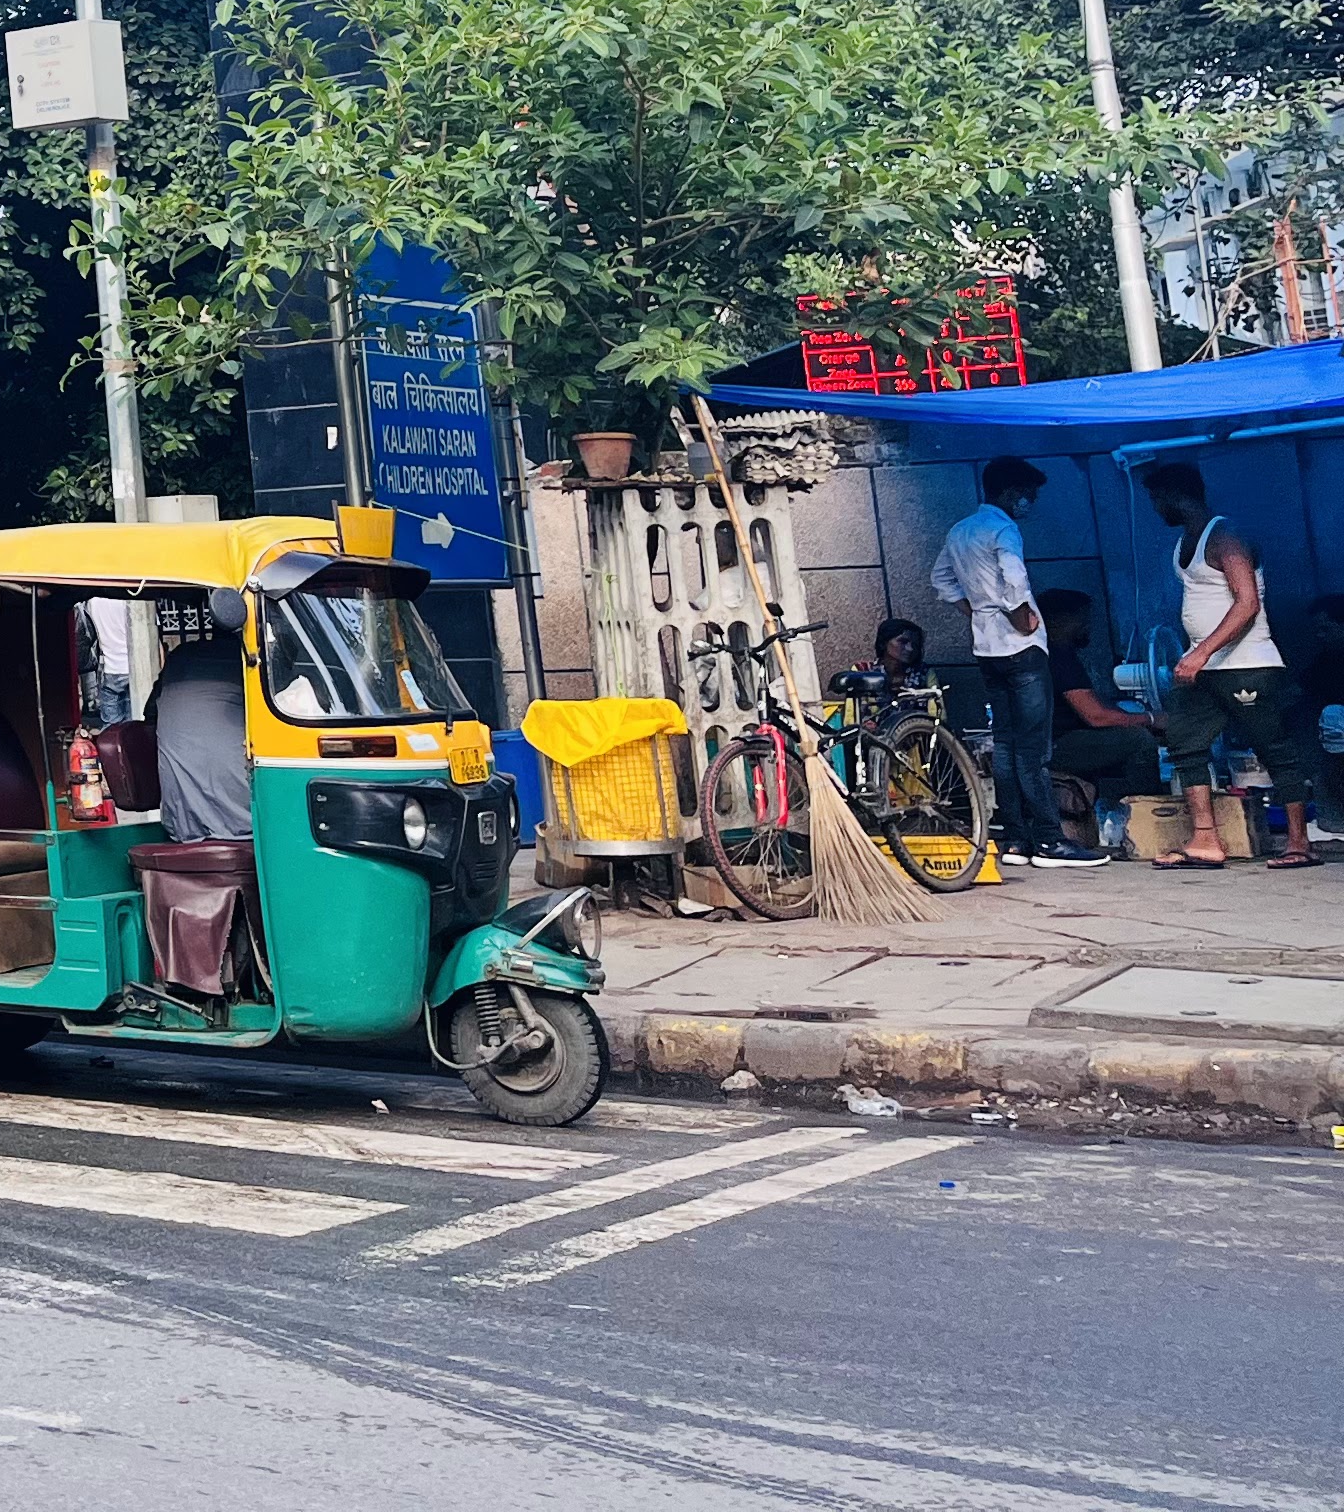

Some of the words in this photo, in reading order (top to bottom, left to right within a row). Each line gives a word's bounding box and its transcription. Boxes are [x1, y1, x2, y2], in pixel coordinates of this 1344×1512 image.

[370, 380, 398, 410] बाल
[403, 371, 480, 416] चिकित्सालय
[382, 425, 438, 457] KALAWATI
[439, 428, 477, 458] SARAN
[378, 462, 433, 495] CHILDREN
[436, 466, 490, 496] HOSPITAL
